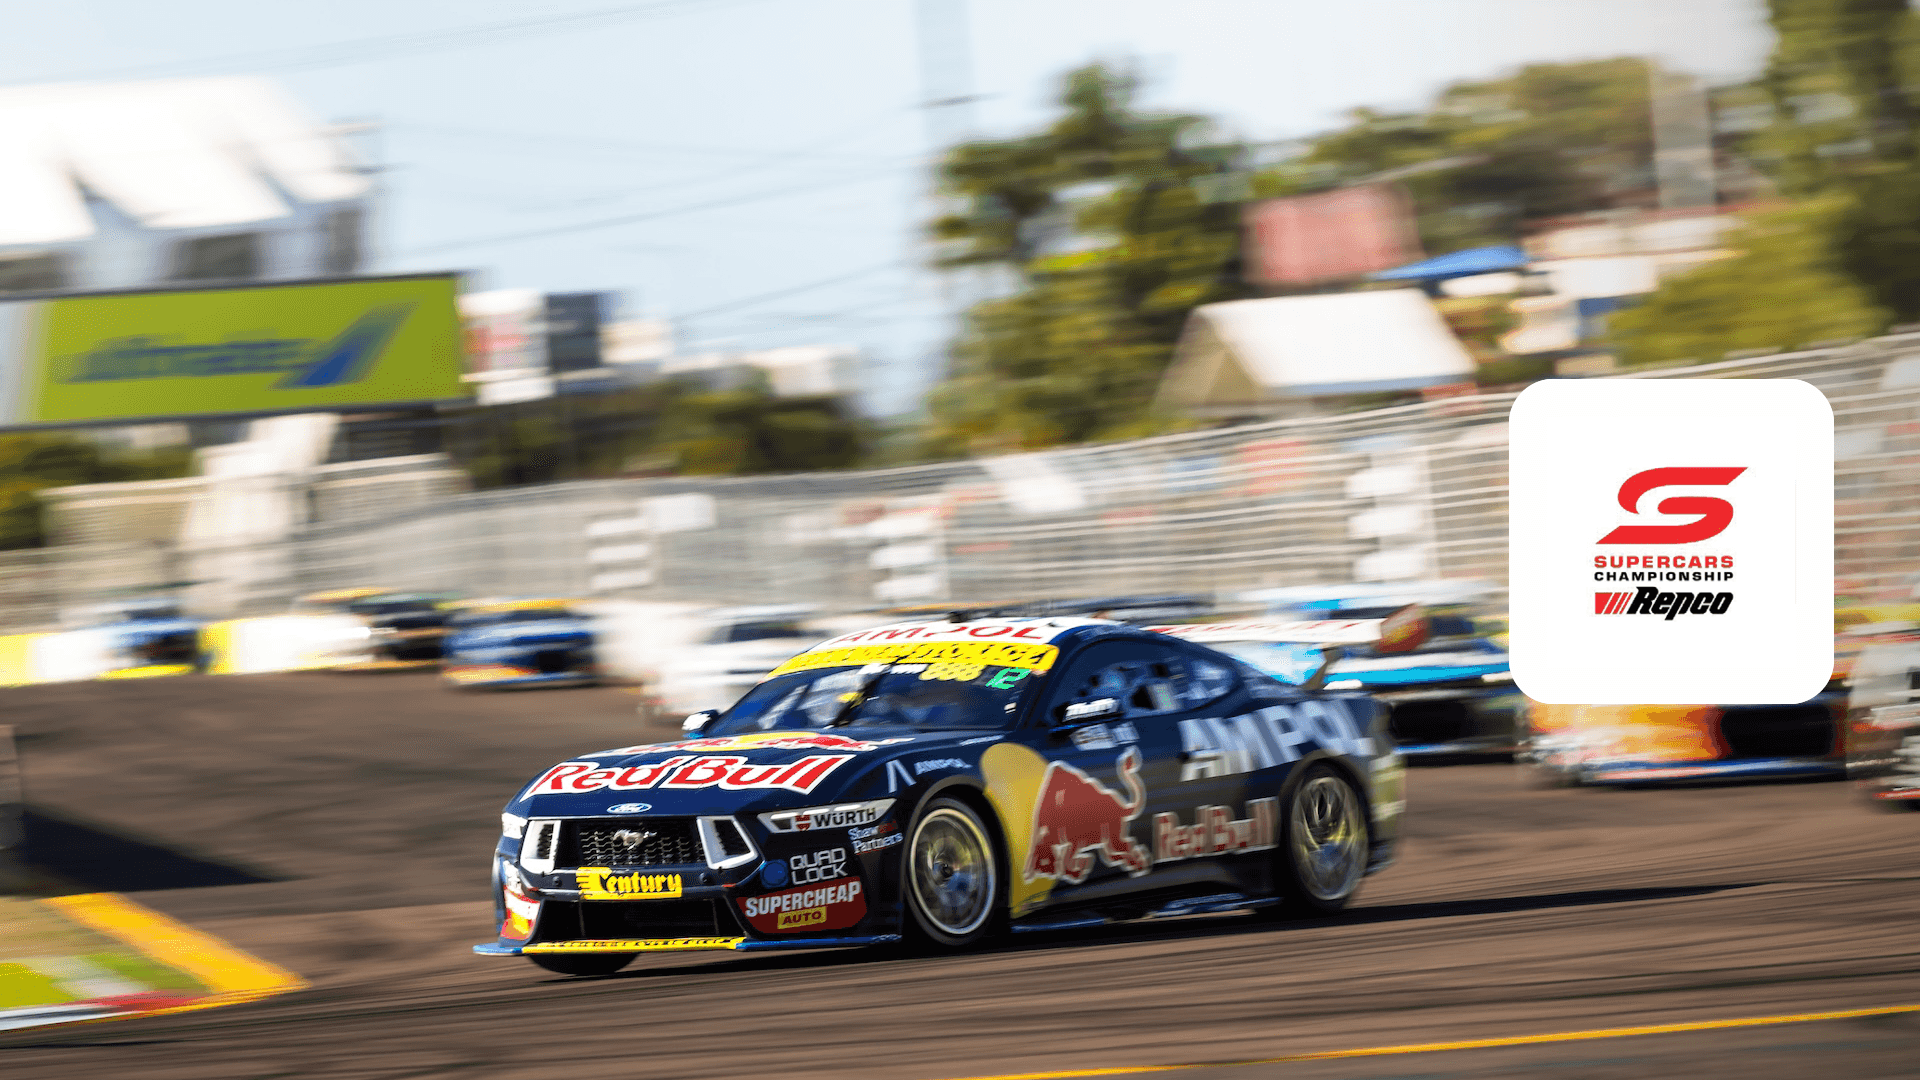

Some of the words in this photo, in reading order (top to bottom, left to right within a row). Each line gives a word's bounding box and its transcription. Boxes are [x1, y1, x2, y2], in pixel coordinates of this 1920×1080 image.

[828, 625, 1044, 645] AMPOL
[1178, 699, 1377, 781] AMPOL
[521, 755, 690, 801] Red
[662, 753, 856, 796] Bull
[1152, 804, 1208, 863] Red
[1204, 796, 1279, 856] Bull
[790, 847, 846, 870] QUAD
[791, 862, 848, 885] LOCK
[576, 866, 683, 900] Century
[745, 881, 861, 917] SUPERCHEAP
[782, 910, 822, 926] AUTO
